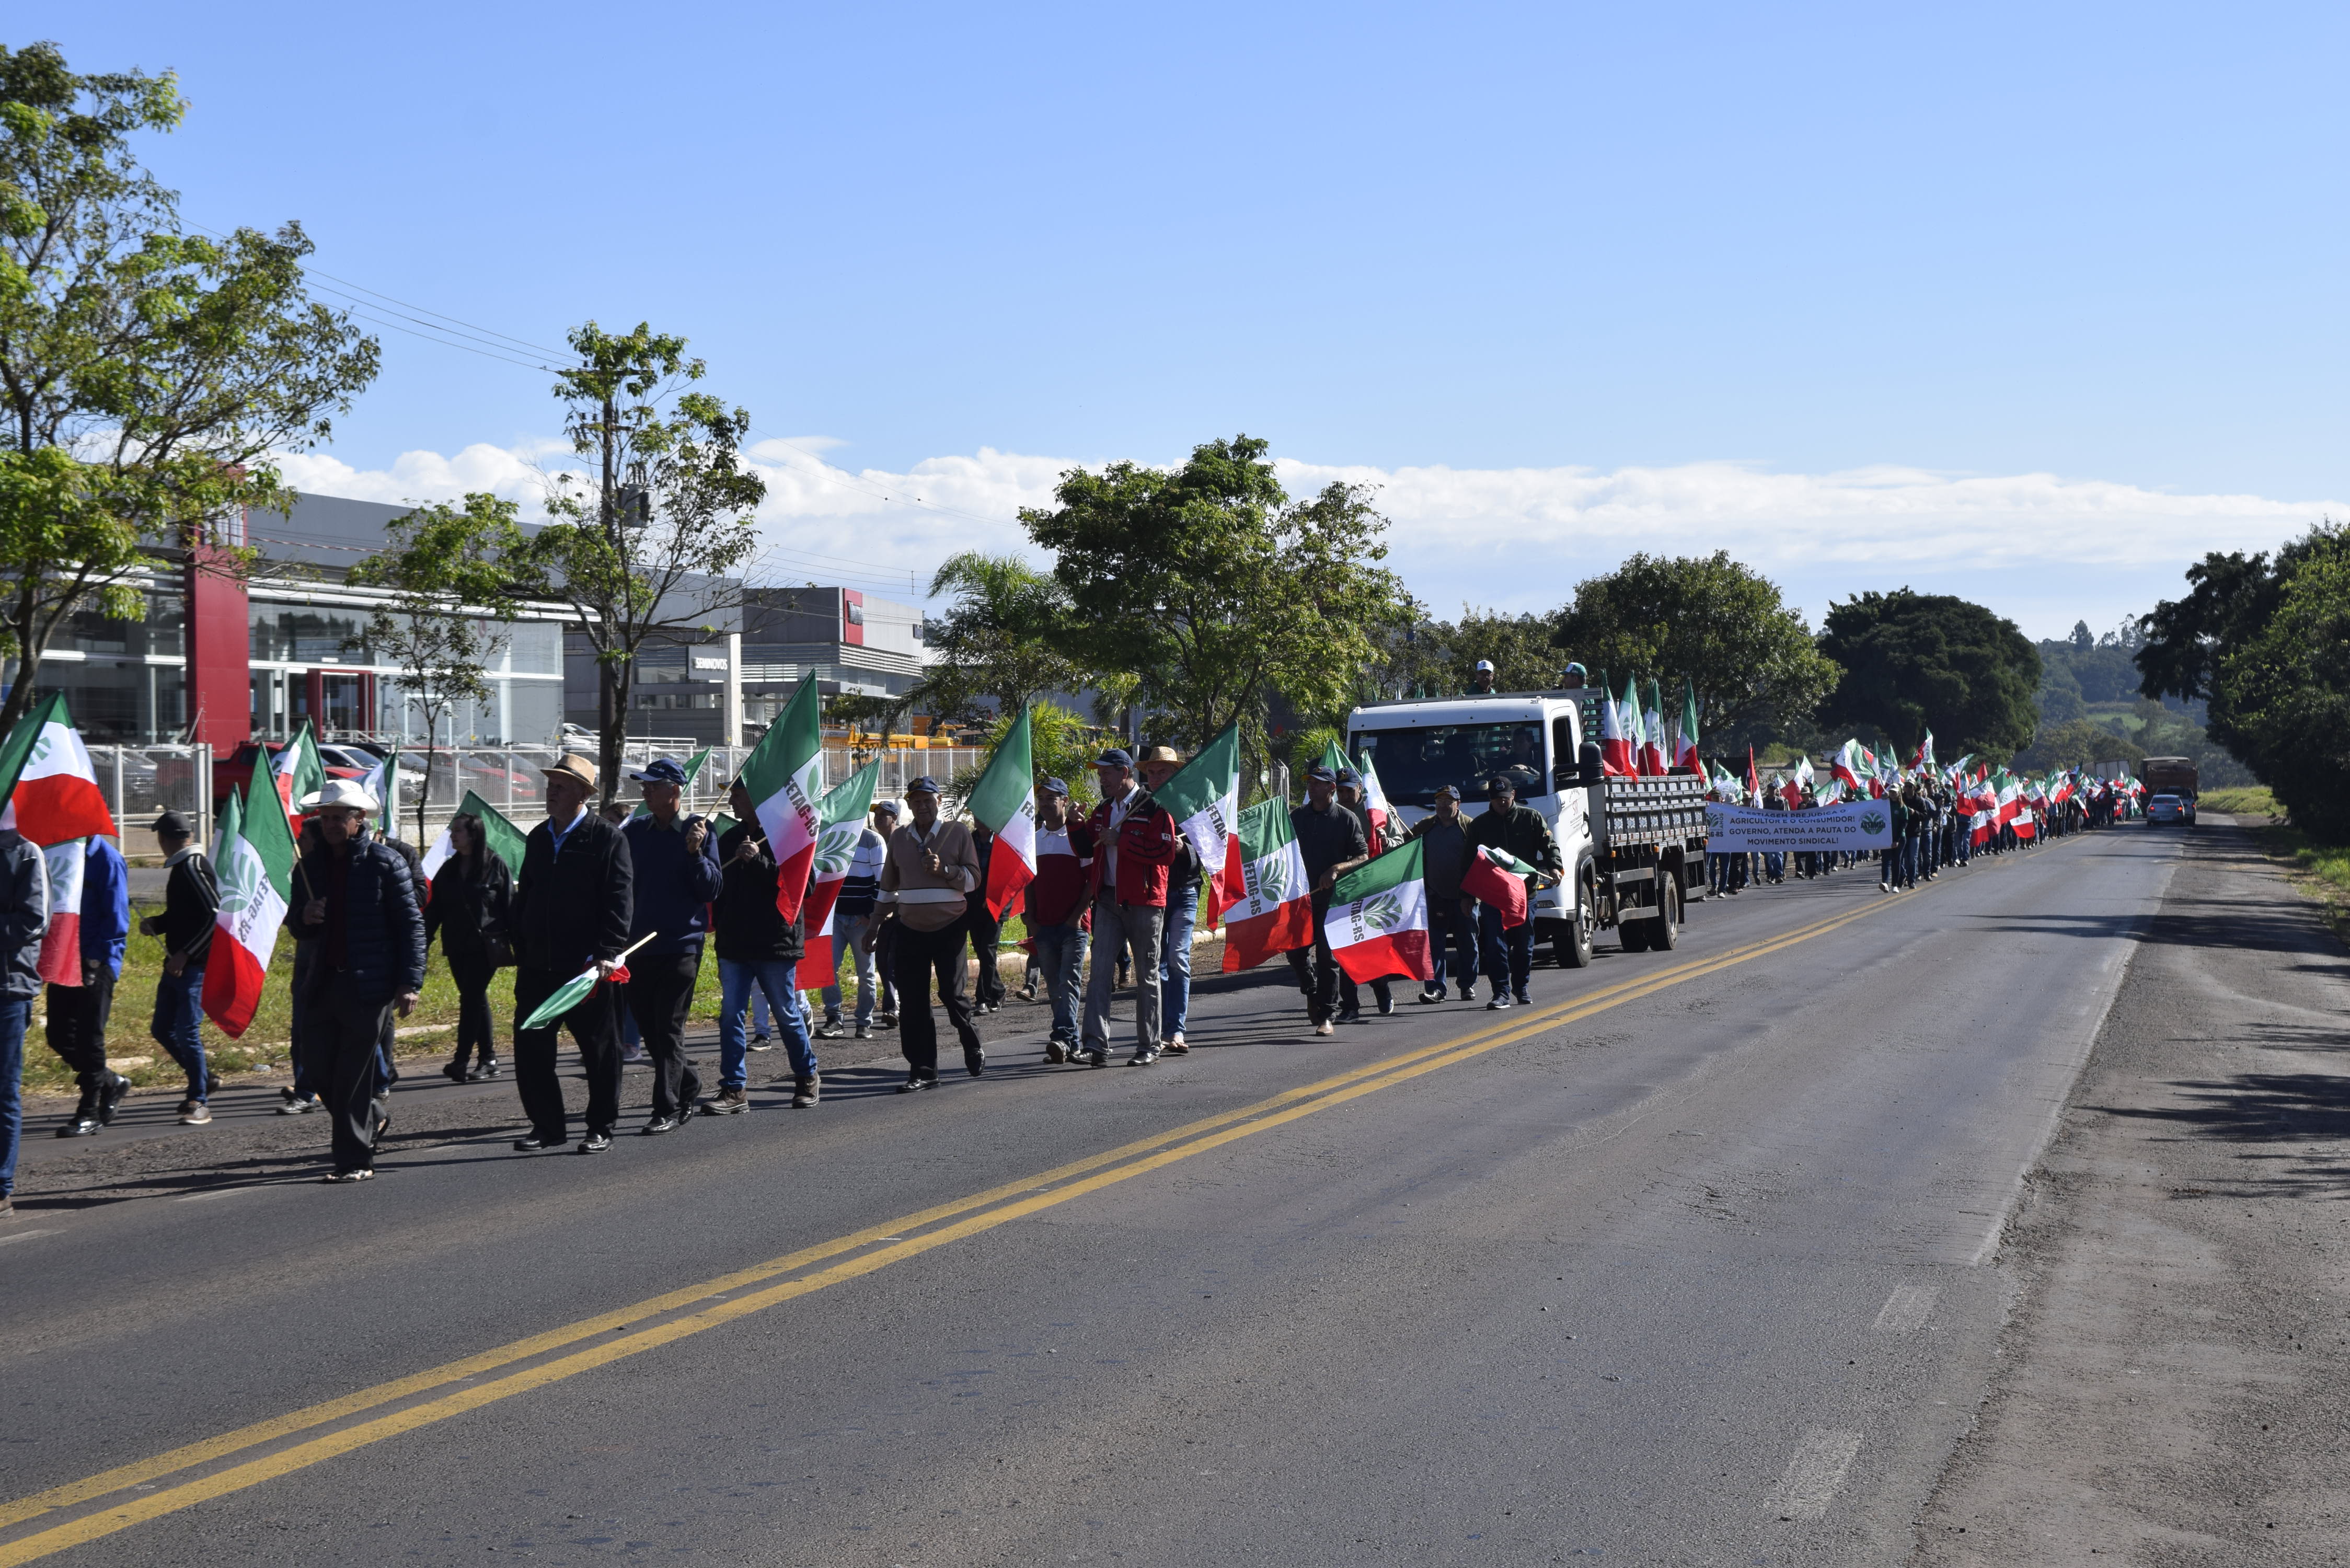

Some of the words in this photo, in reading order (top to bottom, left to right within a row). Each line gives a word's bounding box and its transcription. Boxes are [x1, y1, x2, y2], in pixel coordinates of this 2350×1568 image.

[694, 657, 728, 670] SEMINOVOS
[784, 776, 820, 837] FETAG-RS
[1243, 862, 1262, 916] FETAG-RS
[1351, 898, 1364, 941] FETAG-RS
